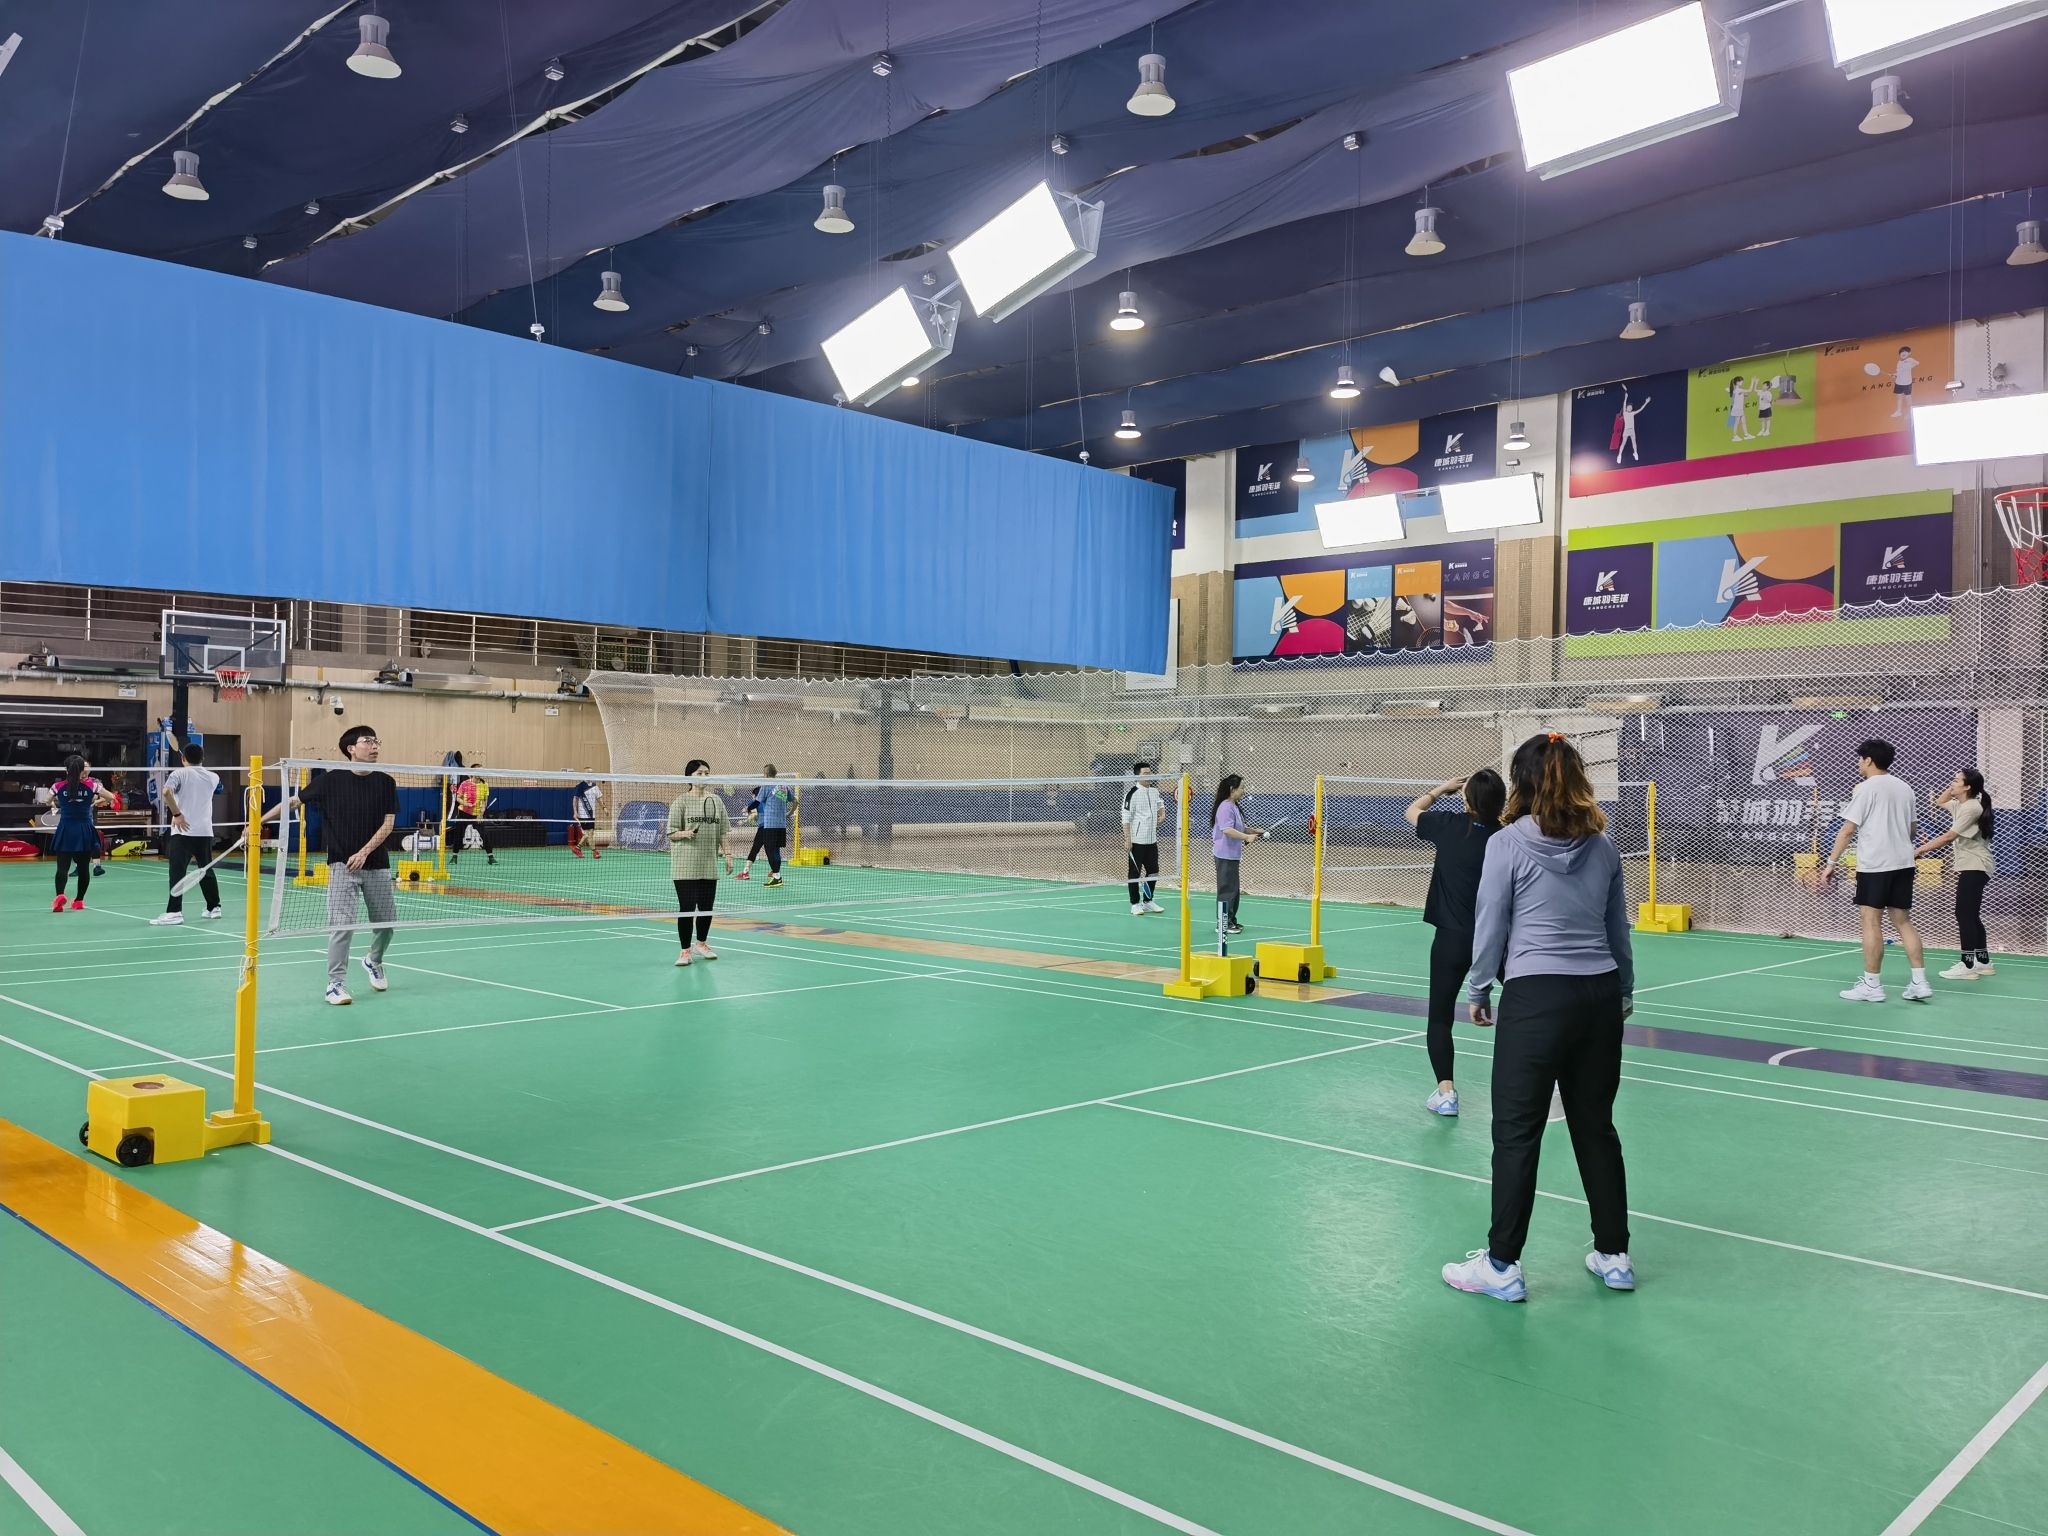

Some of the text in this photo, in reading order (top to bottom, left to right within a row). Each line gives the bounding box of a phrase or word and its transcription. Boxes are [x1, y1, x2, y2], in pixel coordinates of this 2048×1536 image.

[1862, 376, 1933, 391] KANGENG
[1444, 432, 1464, 454] K
[1257, 463, 1273, 482] K
[1881, 545, 1909, 570] K
[1595, 570, 1618, 593] K
[1715, 555, 1769, 604] K
[1865, 571, 1924, 586] 康城羽毛球
[1583, 593, 1630, 606] 康城羽毛球
[1270, 594, 1304, 635] K
[1751, 724, 1826, 786] K
